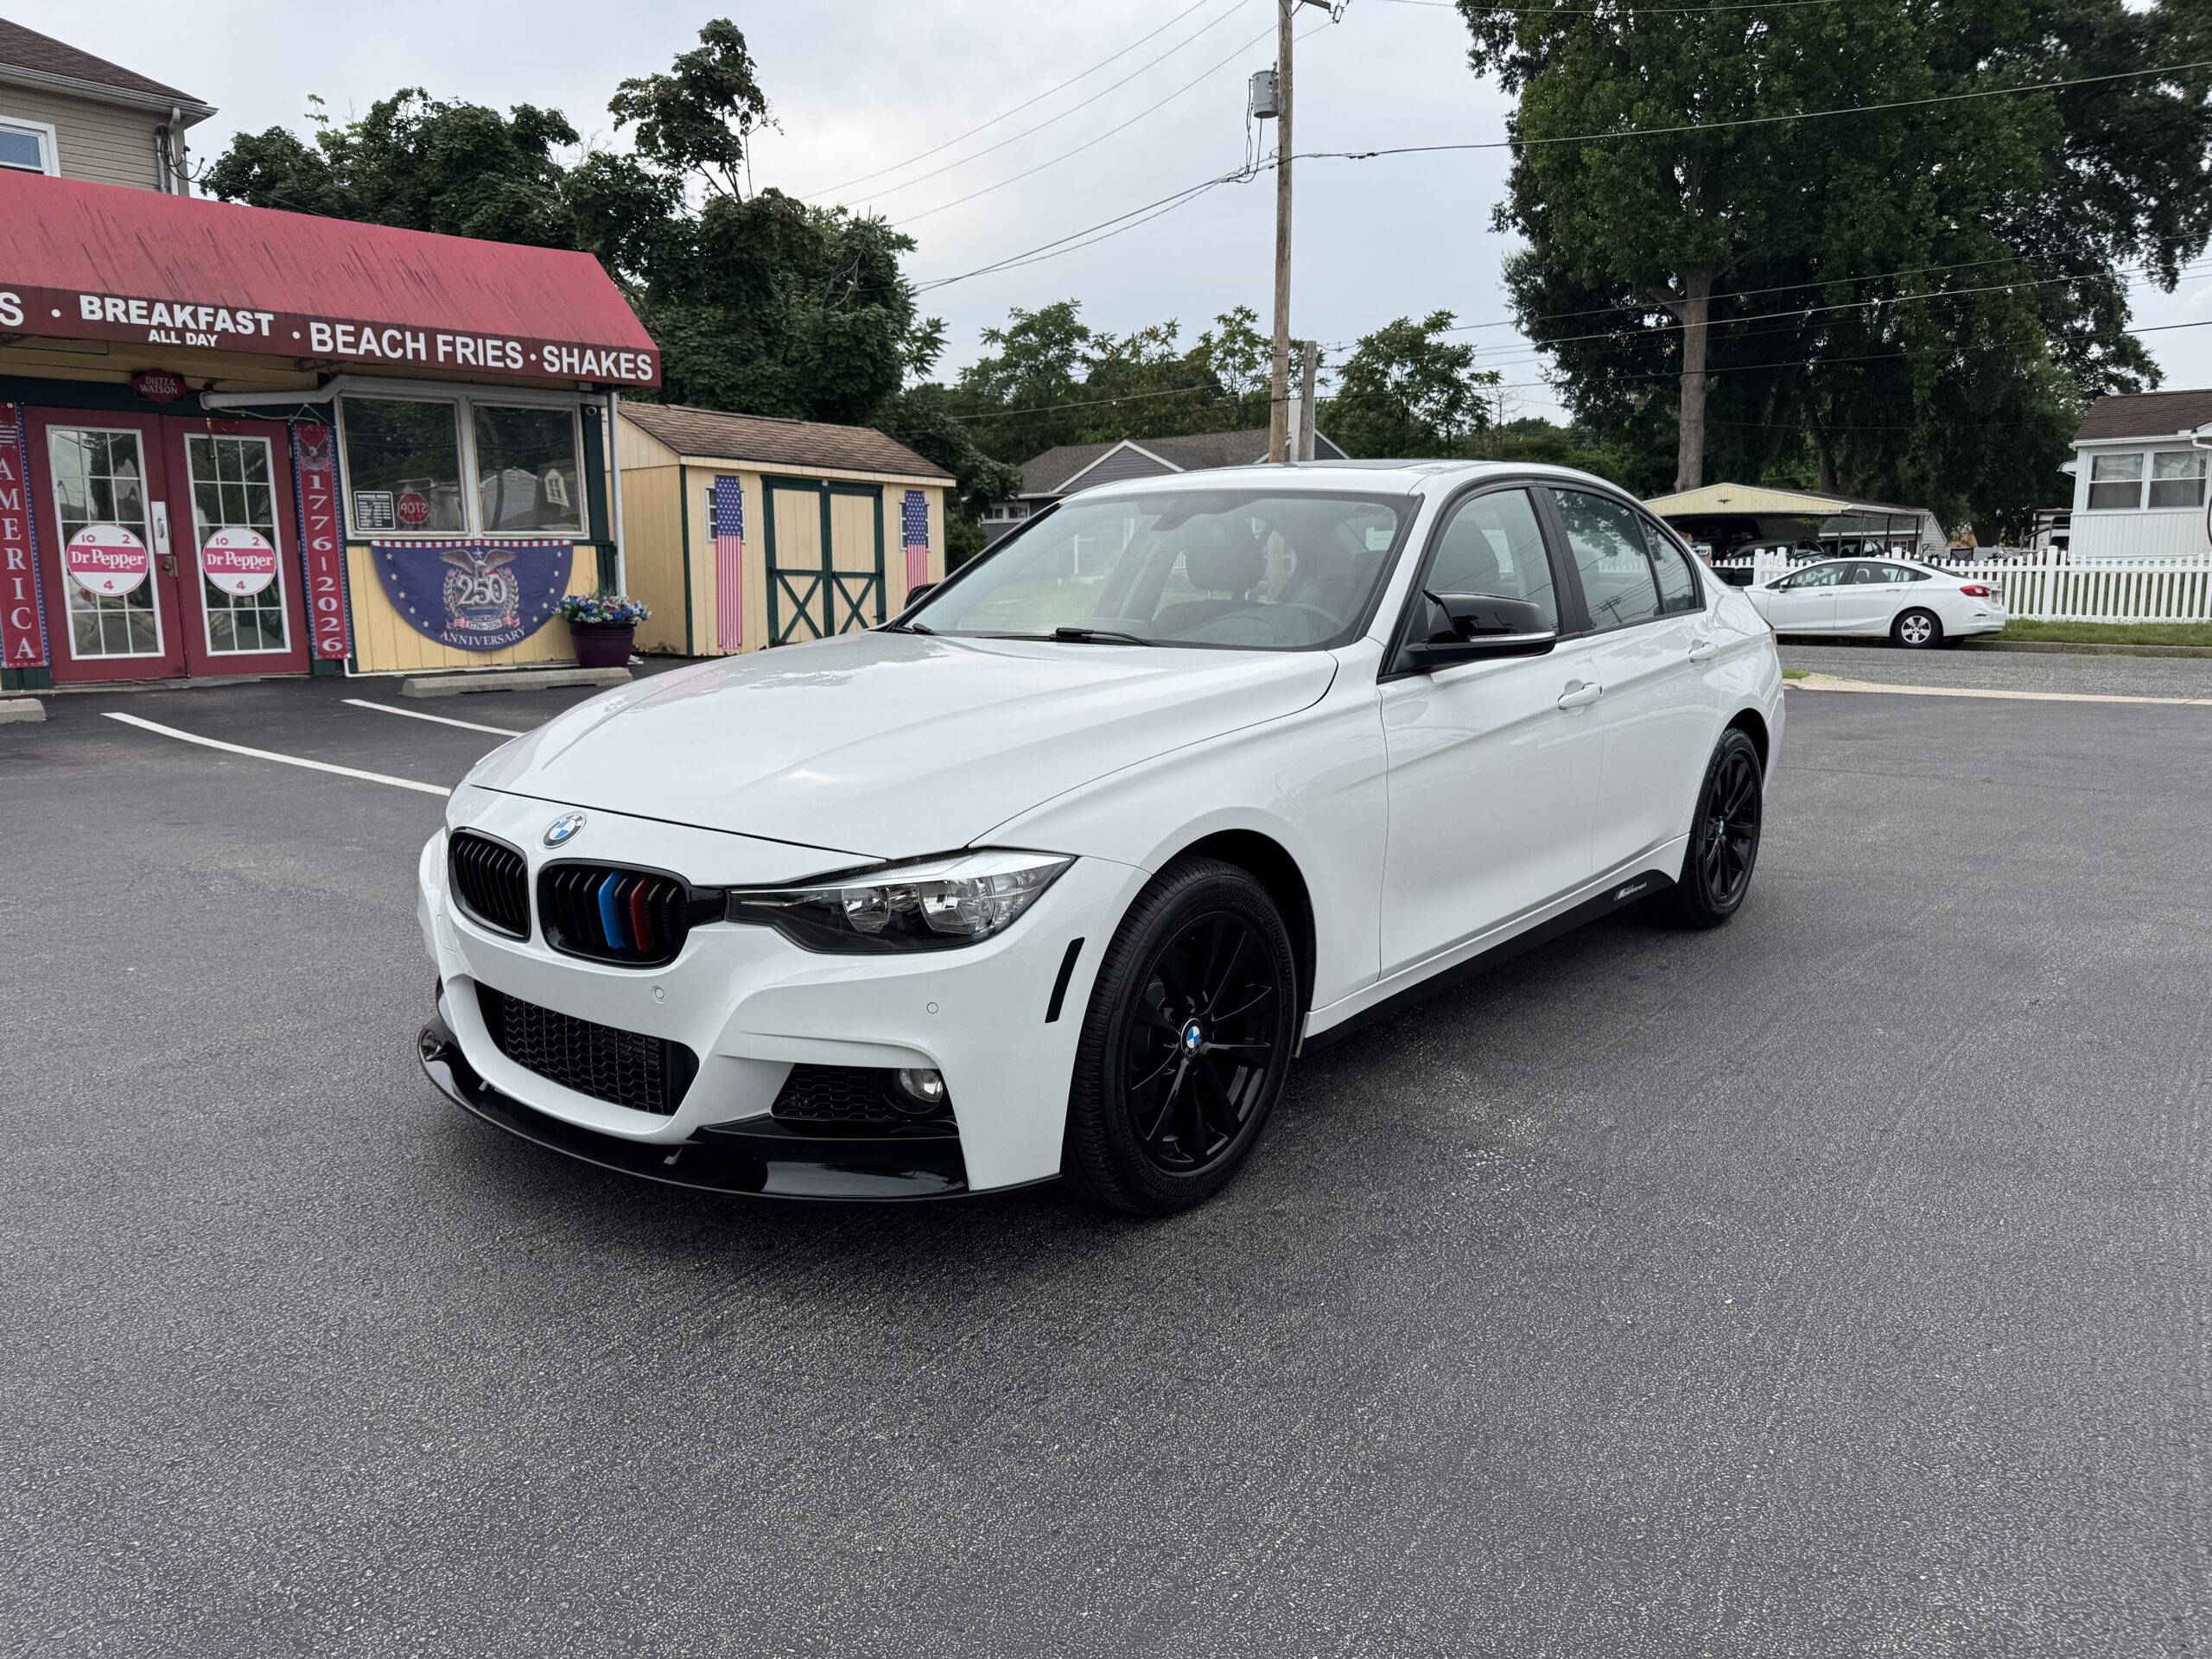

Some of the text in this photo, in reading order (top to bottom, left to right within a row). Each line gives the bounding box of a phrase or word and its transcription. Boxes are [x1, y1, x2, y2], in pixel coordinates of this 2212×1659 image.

[79, 295, 274, 336] BREAKFAST
[309, 321, 426, 360] BEACH
[435, 334, 524, 369] FRIES
[543, 345, 653, 381] SHAKES
[148, 329, 218, 346] ALL DAY
[145, 376, 168, 385] DIETZ
[139, 384, 178, 395] WATSON
[81, 534, 130, 544] 10 2
[251, 537, 260, 546] 2
[0, 457, 36, 659] AMERICA
[70, 549, 145, 569] Dr Pepper
[207, 550, 273, 570] Dr Pepper
[103, 580, 114, 591] 4
[236, 580, 245, 591] 4
[456, 575, 507, 605] 250
[439, 626, 525, 646] ANNIVERSARY
